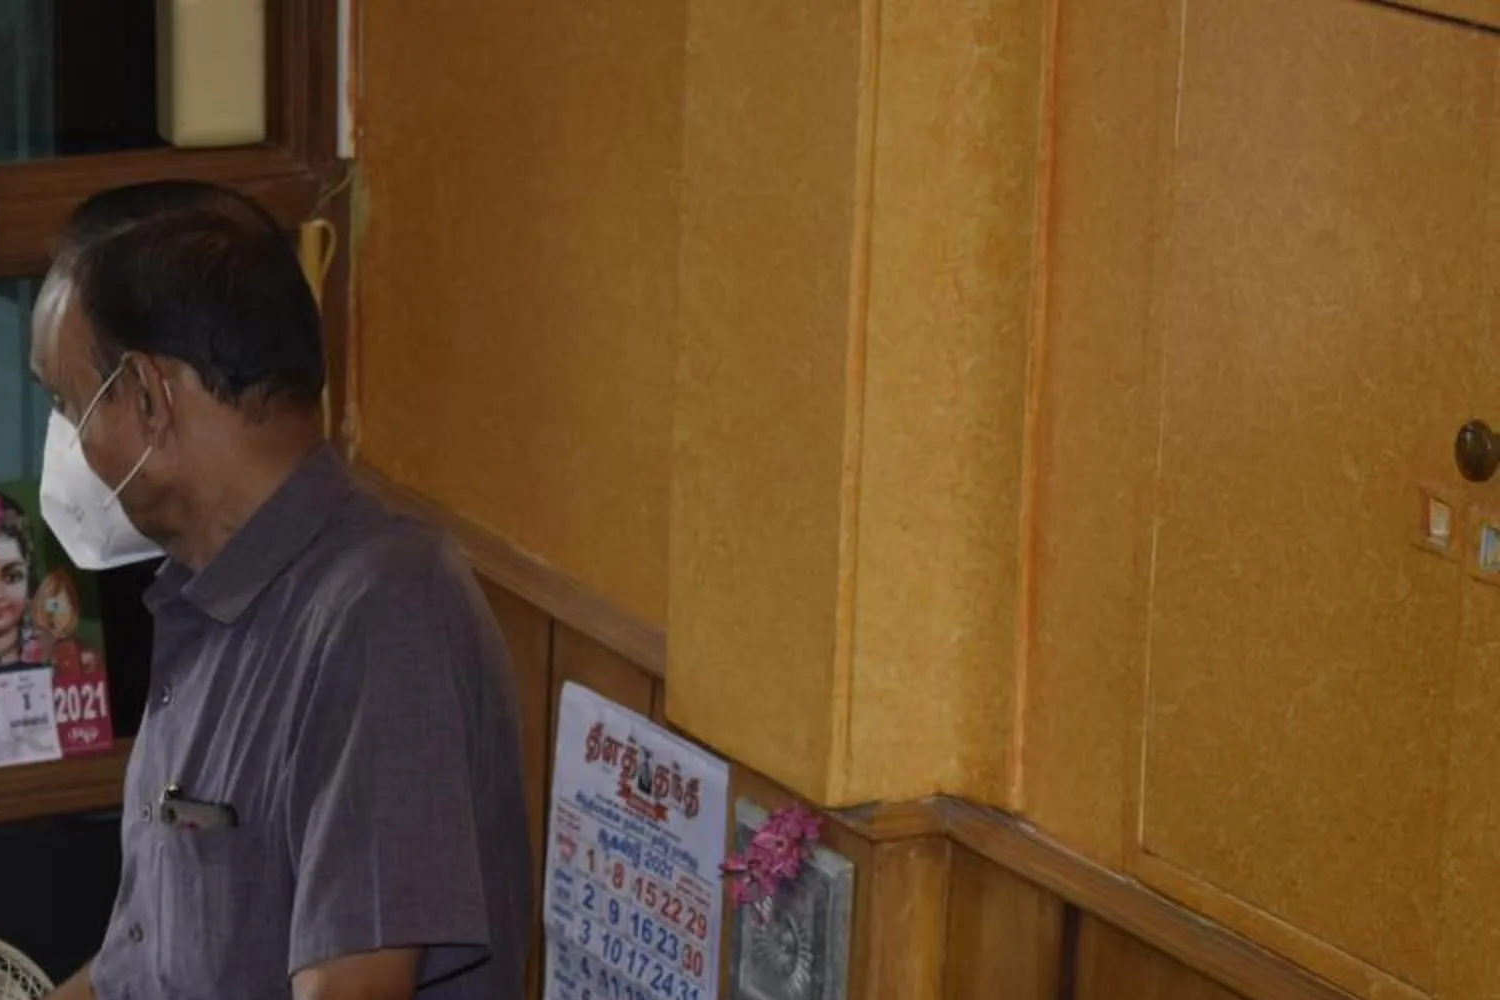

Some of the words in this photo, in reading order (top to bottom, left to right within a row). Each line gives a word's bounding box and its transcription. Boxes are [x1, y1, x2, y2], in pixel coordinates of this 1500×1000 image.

[55, 683, 107, 723] 2021
[582, 884, 596, 910] 2
[608, 897, 620, 925] 9
[631, 911, 653, 944] 16
[657, 923, 679, 961] 23
[681, 943, 704, 977] 30
[586, 849, 596, 873] 1
[612, 861, 625, 890] 8
[634, 876, 658, 908] 15
[658, 886, 682, 925] 22
[686, 905, 708, 941] 29
[578, 919, 592, 945] 3
[601, 932, 622, 964] 10
[627, 949, 649, 980] 17
[650, 963, 674, 998] 24
